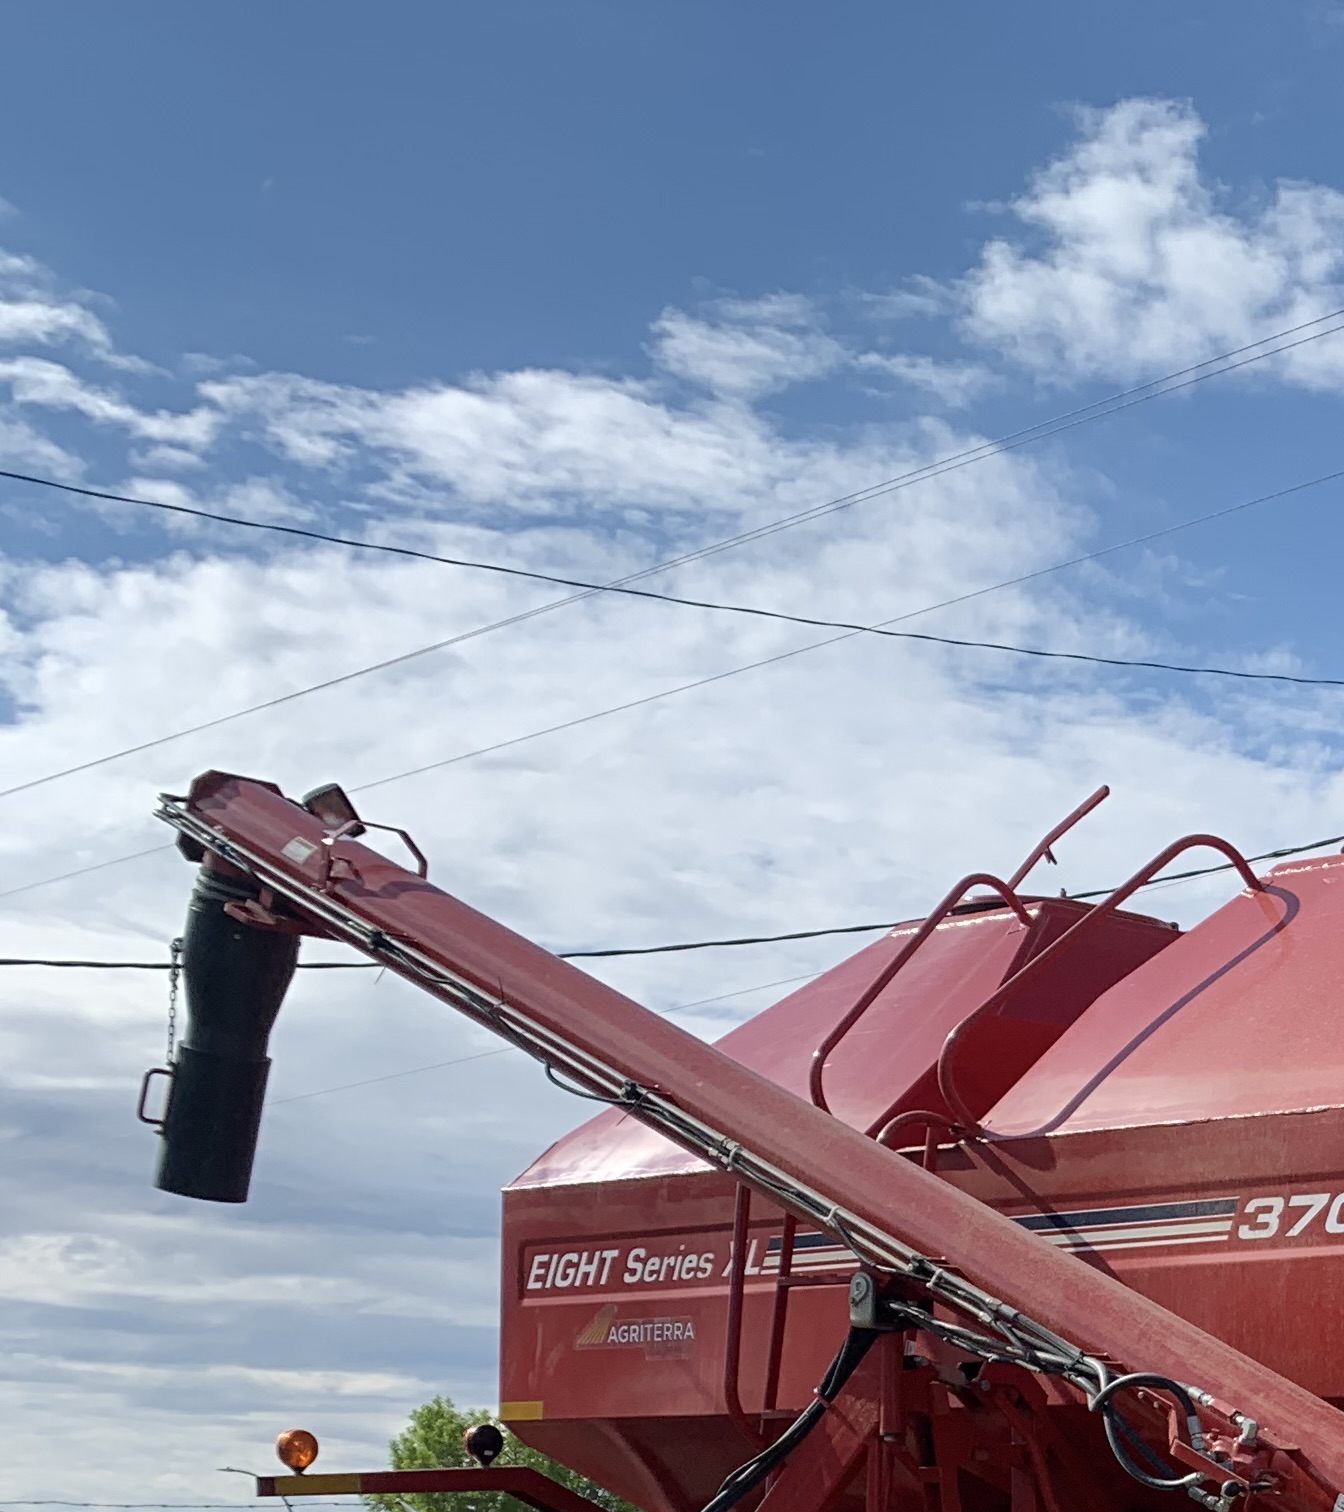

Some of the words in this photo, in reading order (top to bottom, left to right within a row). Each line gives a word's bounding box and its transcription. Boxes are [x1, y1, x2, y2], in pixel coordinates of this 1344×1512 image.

[526, 1248, 620, 1290] EIGHT
[623, 1244, 715, 1284] Series
[607, 1321, 695, 1344] AGRITERRA
